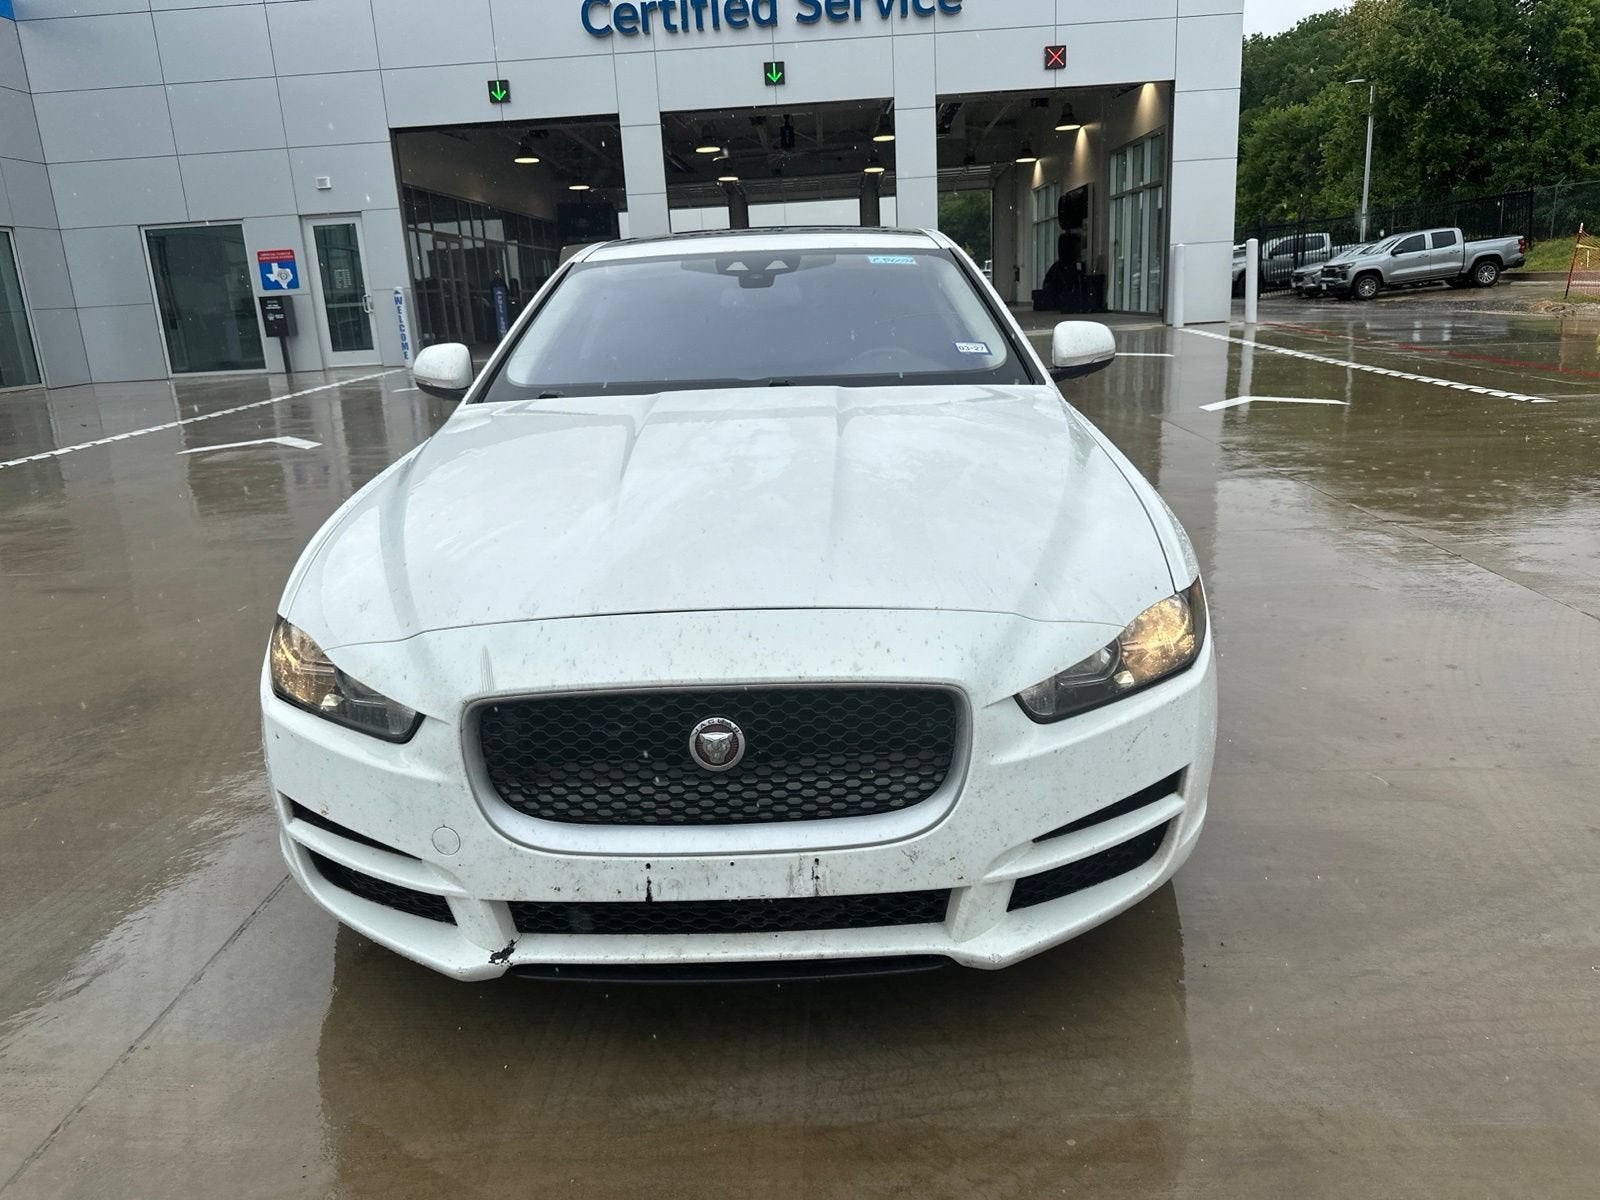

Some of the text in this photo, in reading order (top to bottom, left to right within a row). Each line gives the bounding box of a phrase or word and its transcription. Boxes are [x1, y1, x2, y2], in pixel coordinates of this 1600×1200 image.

[581, 0, 778, 37] Certified
[393, 296, 409, 360] WELCOME
[693, 718, 741, 736] JAGUAR
